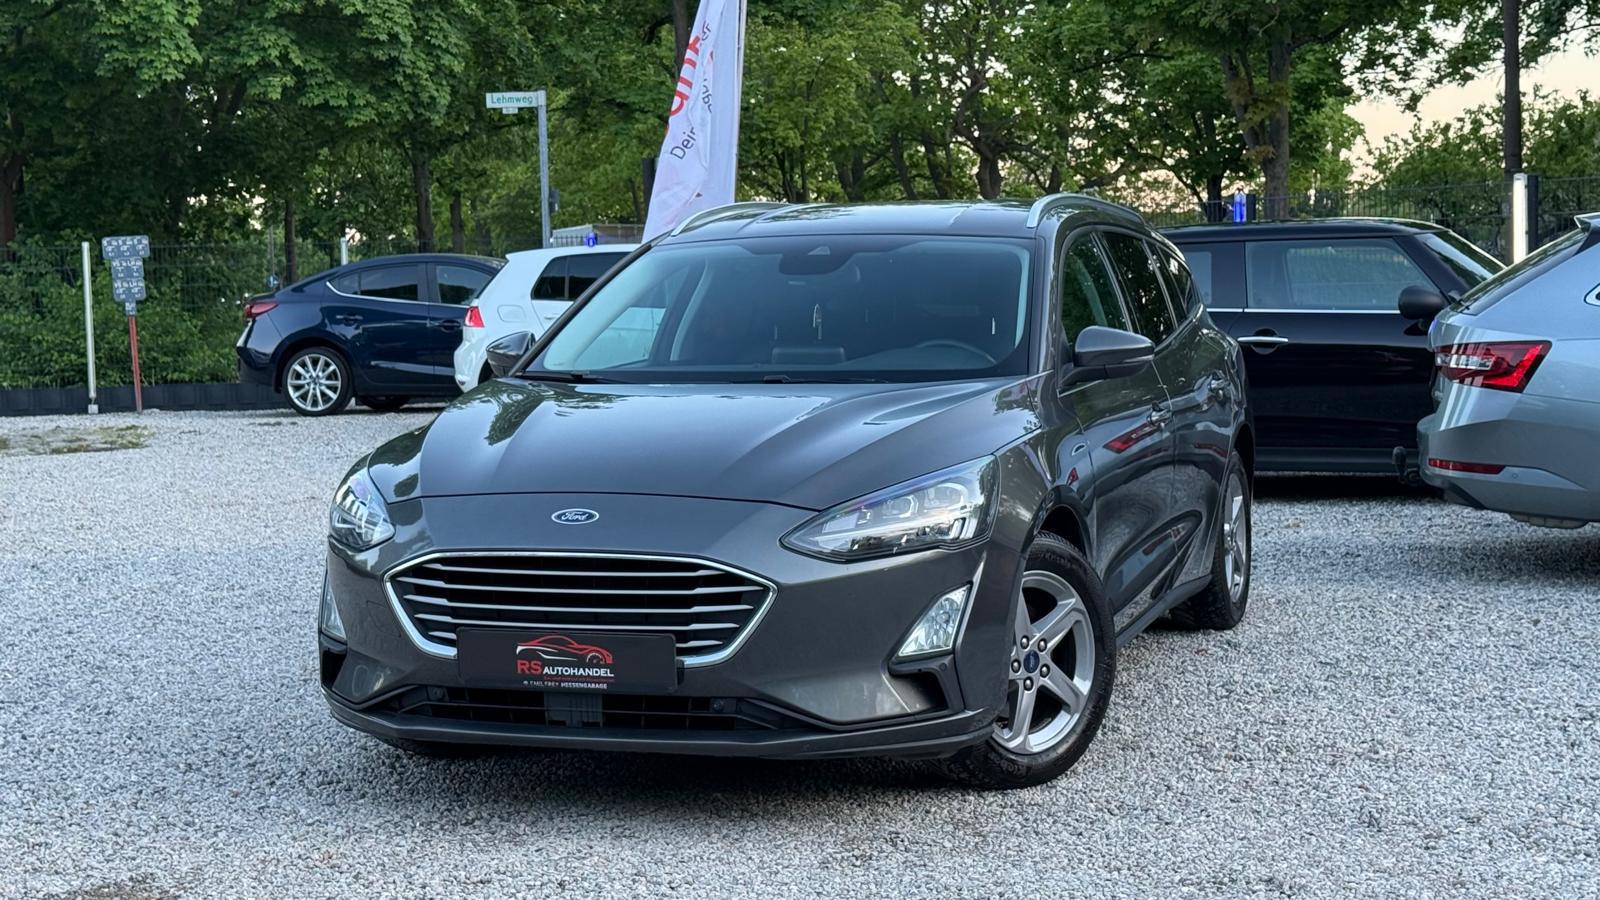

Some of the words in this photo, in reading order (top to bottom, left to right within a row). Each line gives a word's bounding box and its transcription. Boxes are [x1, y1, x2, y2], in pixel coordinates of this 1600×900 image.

[491, 94, 533, 105] Lehmweg
[517, 660, 542, 674] RS
[543, 666, 614, 677] AUTOHANDEL
